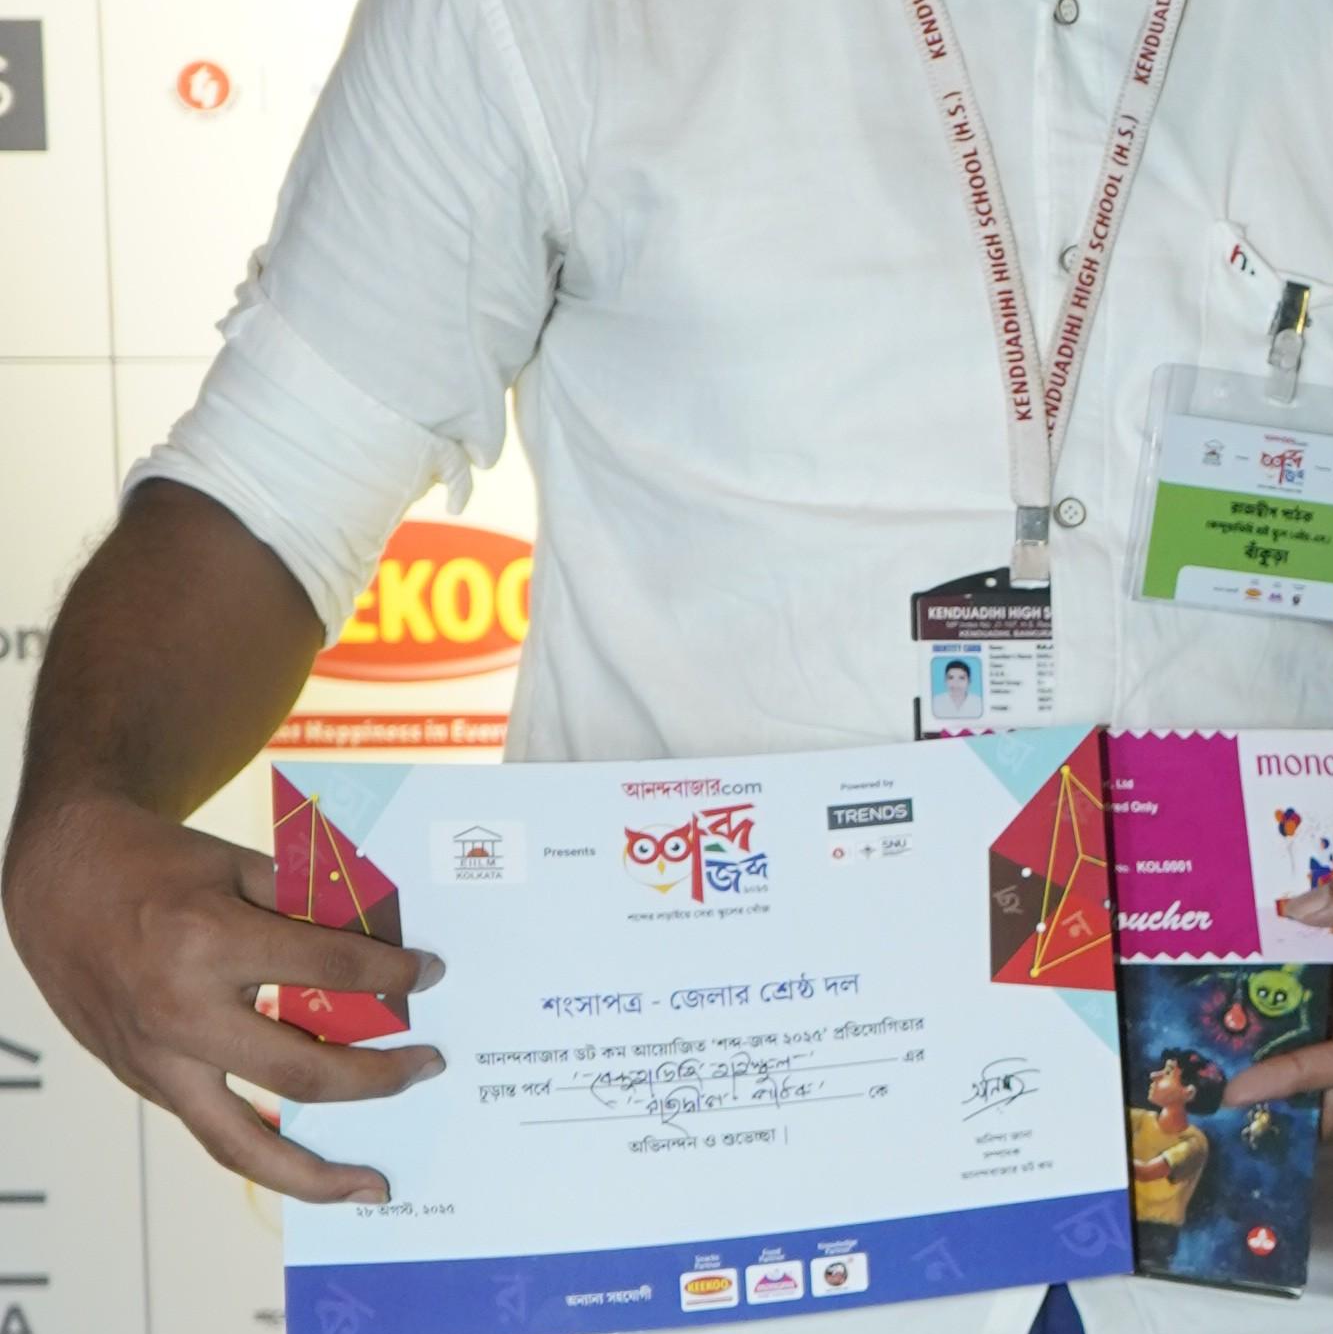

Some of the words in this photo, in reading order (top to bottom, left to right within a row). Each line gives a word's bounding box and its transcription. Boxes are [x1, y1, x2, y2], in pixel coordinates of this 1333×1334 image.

[964, 147, 998, 229] SCHOOL
[984, 233, 1010, 285] HIGH
[1071, 256, 1099, 308] HIGH
[1091, 174, 1125, 253] SCHOOL
[995, 289, 1032, 423] KENDUADIHI
[928, 605, 1007, 620] KENDUADIHI
[1008, 605, 1042, 619] HIGH
[832, 804, 908, 825] TRENDS
[543, 846, 596, 859] Presents
